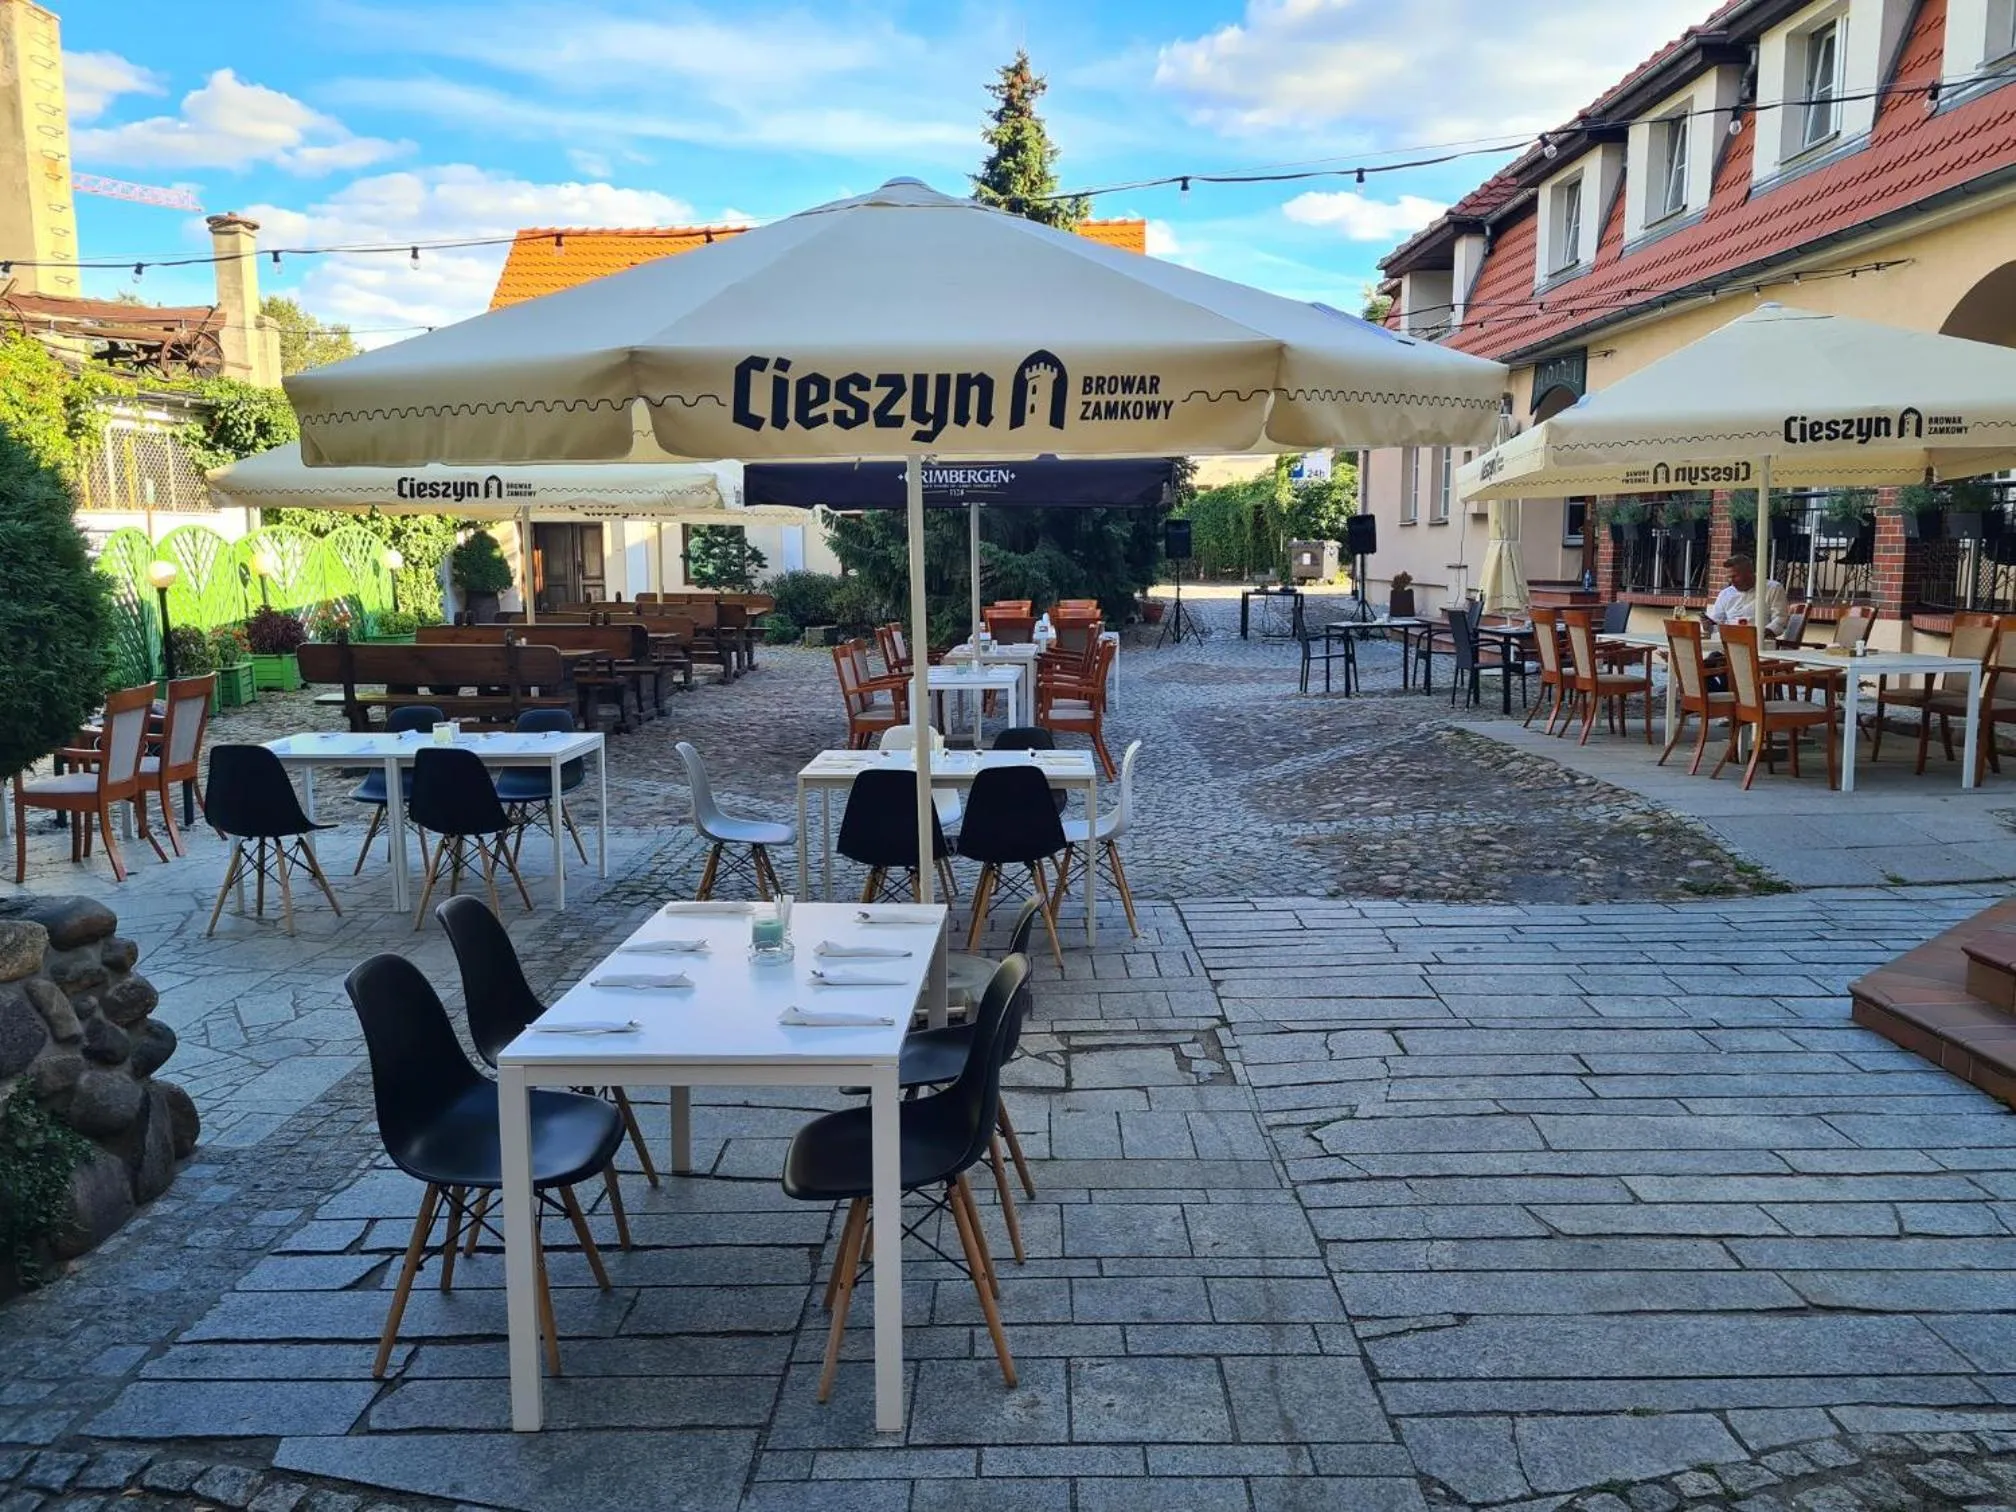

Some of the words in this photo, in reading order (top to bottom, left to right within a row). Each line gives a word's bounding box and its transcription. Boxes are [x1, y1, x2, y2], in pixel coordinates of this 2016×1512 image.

[1082, 375, 1161, 396] BROWAR
[732, 355, 994, 443] Cieszyn
[1079, 400, 1175, 420] ZAMKOWY
[1784, 415, 1892, 444] Cieszyn
[904, 469, 1009, 484] RIMBERGEN
[1307, 468, 1325, 478] 24h
[397, 477, 479, 501] Cieszyn
